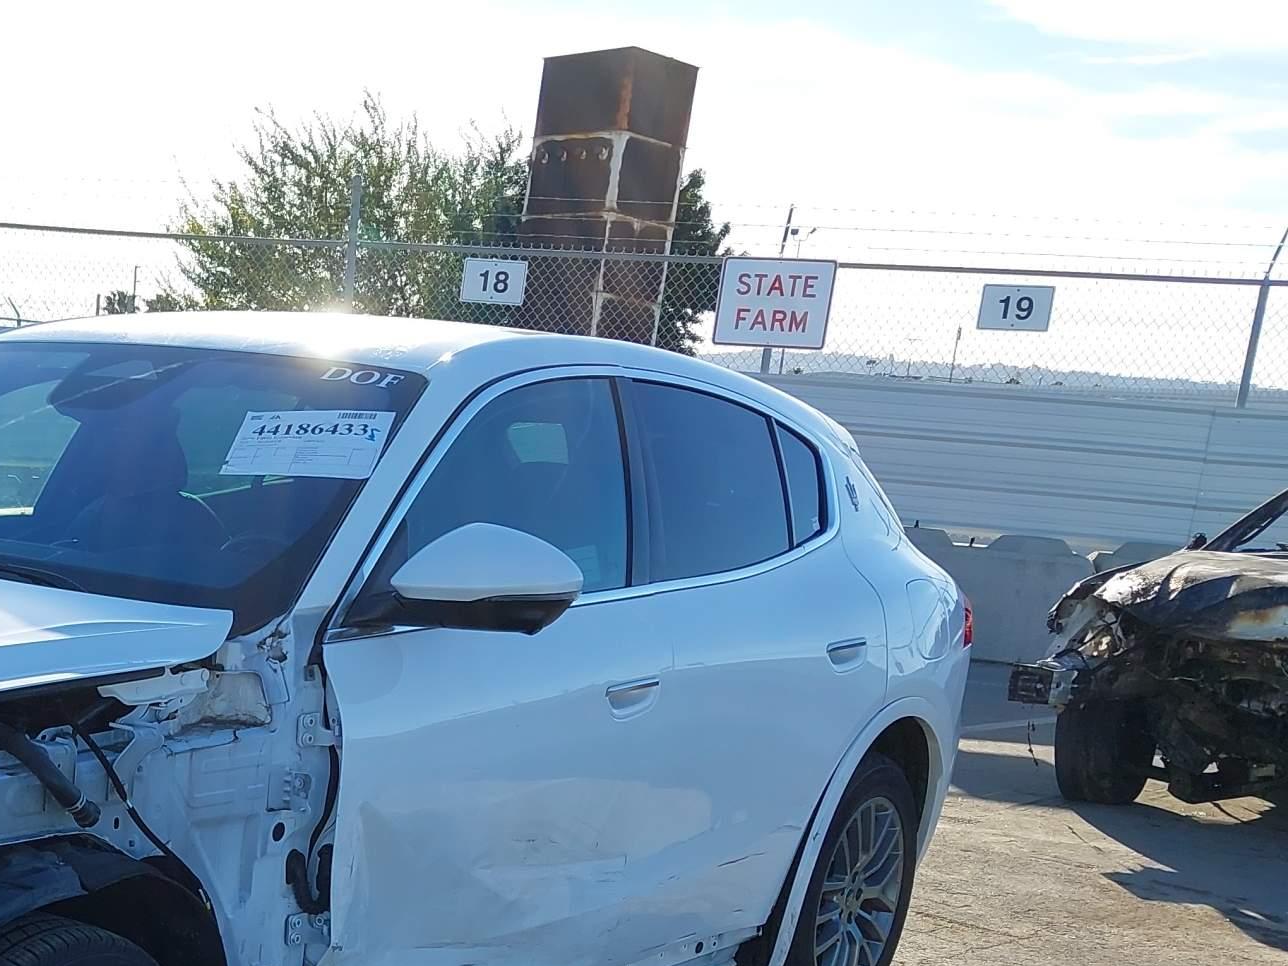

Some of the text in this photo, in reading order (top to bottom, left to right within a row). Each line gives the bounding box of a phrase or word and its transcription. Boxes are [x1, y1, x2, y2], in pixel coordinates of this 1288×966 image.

[479, 269, 510, 294] 18
[736, 272, 819, 298] STATE
[734, 308, 809, 333] FARM
[999, 295, 1034, 321] 19
[319, 366, 406, 389] DOF
[252, 422, 369, 437] 44186433
